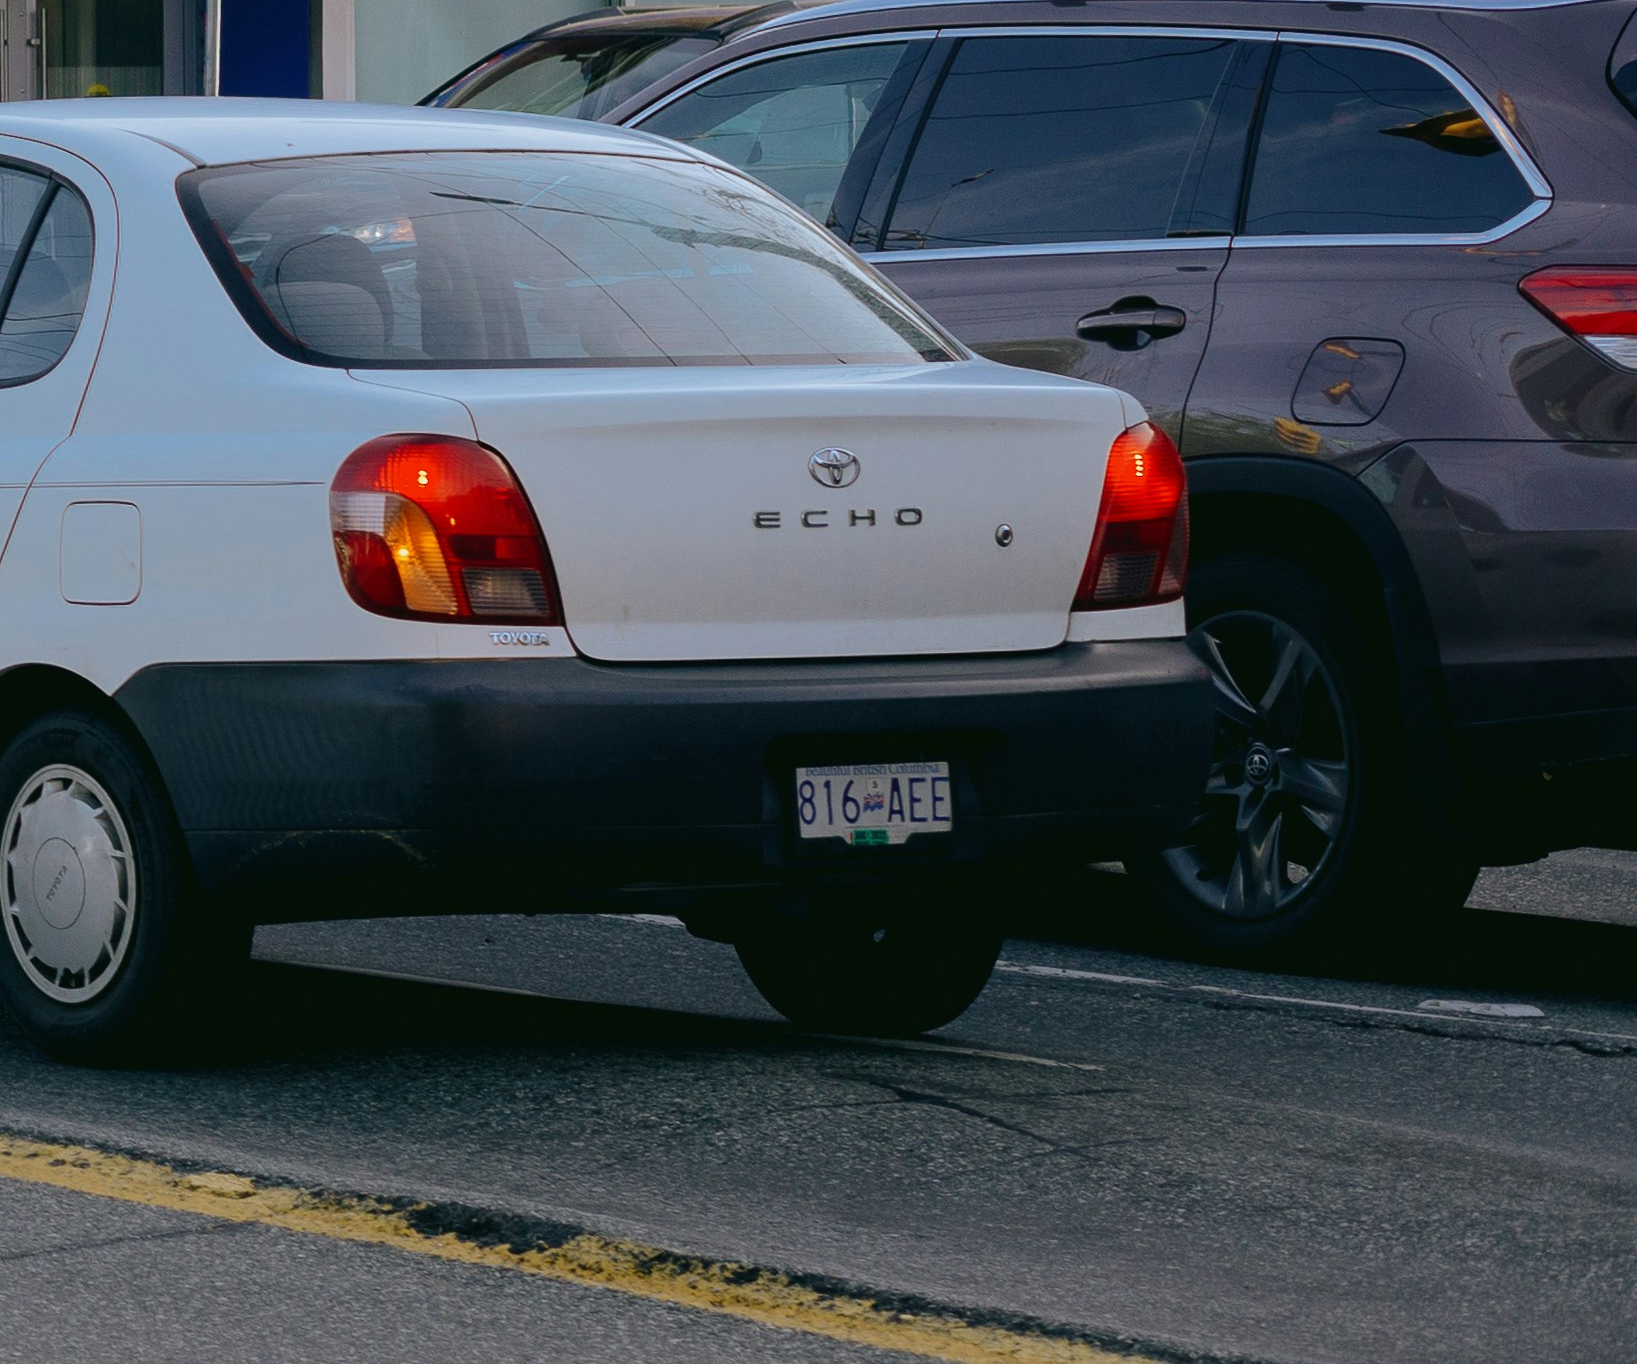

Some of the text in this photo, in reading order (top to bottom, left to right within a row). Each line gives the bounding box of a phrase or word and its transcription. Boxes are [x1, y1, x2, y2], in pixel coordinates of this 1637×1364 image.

[753, 506, 923, 529] ECHO
[490, 632, 549, 645] TOYOTA
[889, 763, 940, 774] Columbia
[799, 777, 951, 825] 816 AEE
[47, 865, 68, 901] TOYOTA
